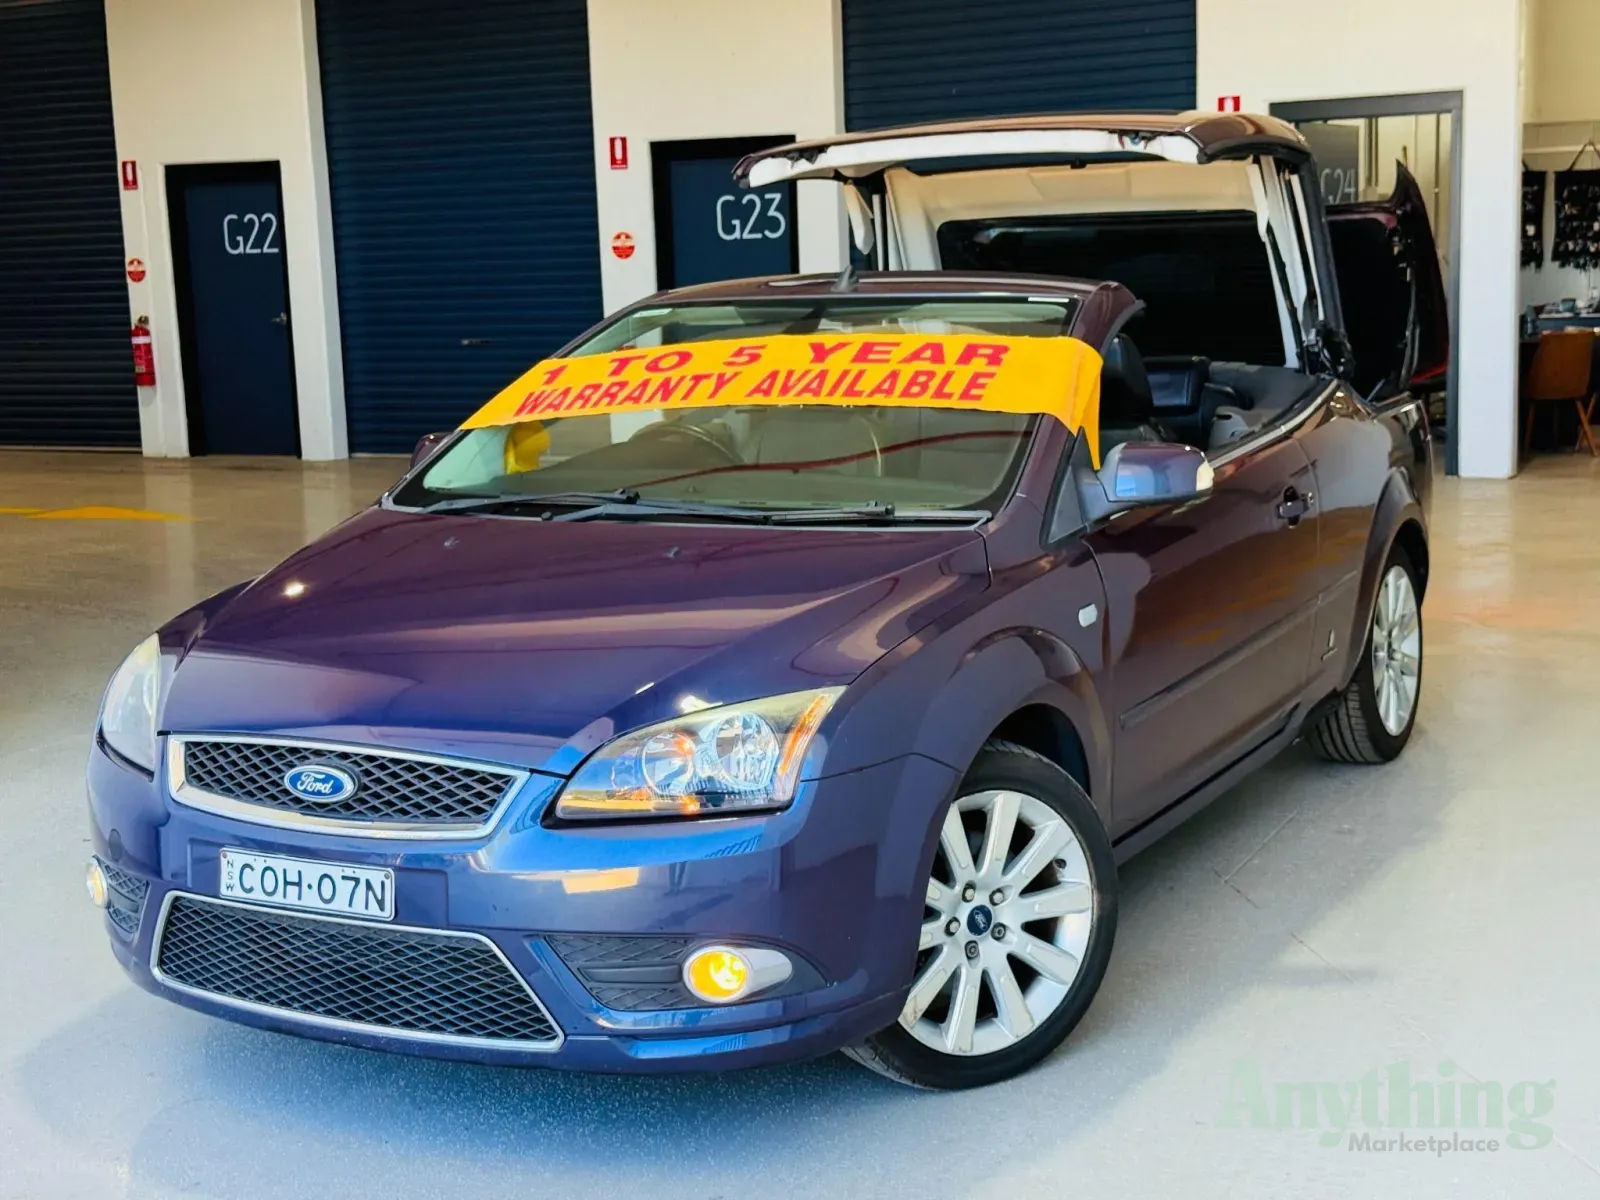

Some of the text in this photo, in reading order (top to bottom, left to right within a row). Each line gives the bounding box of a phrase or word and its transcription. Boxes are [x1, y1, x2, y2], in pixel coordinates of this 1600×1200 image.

[223, 213, 280, 255] G22
[716, 193, 786, 240] G23
[542, 341, 1010, 385] 1 TO 5 YEAR
[512, 369, 998, 417] WARRANTY AVAILABLE
[296, 771, 334, 794] Ford
